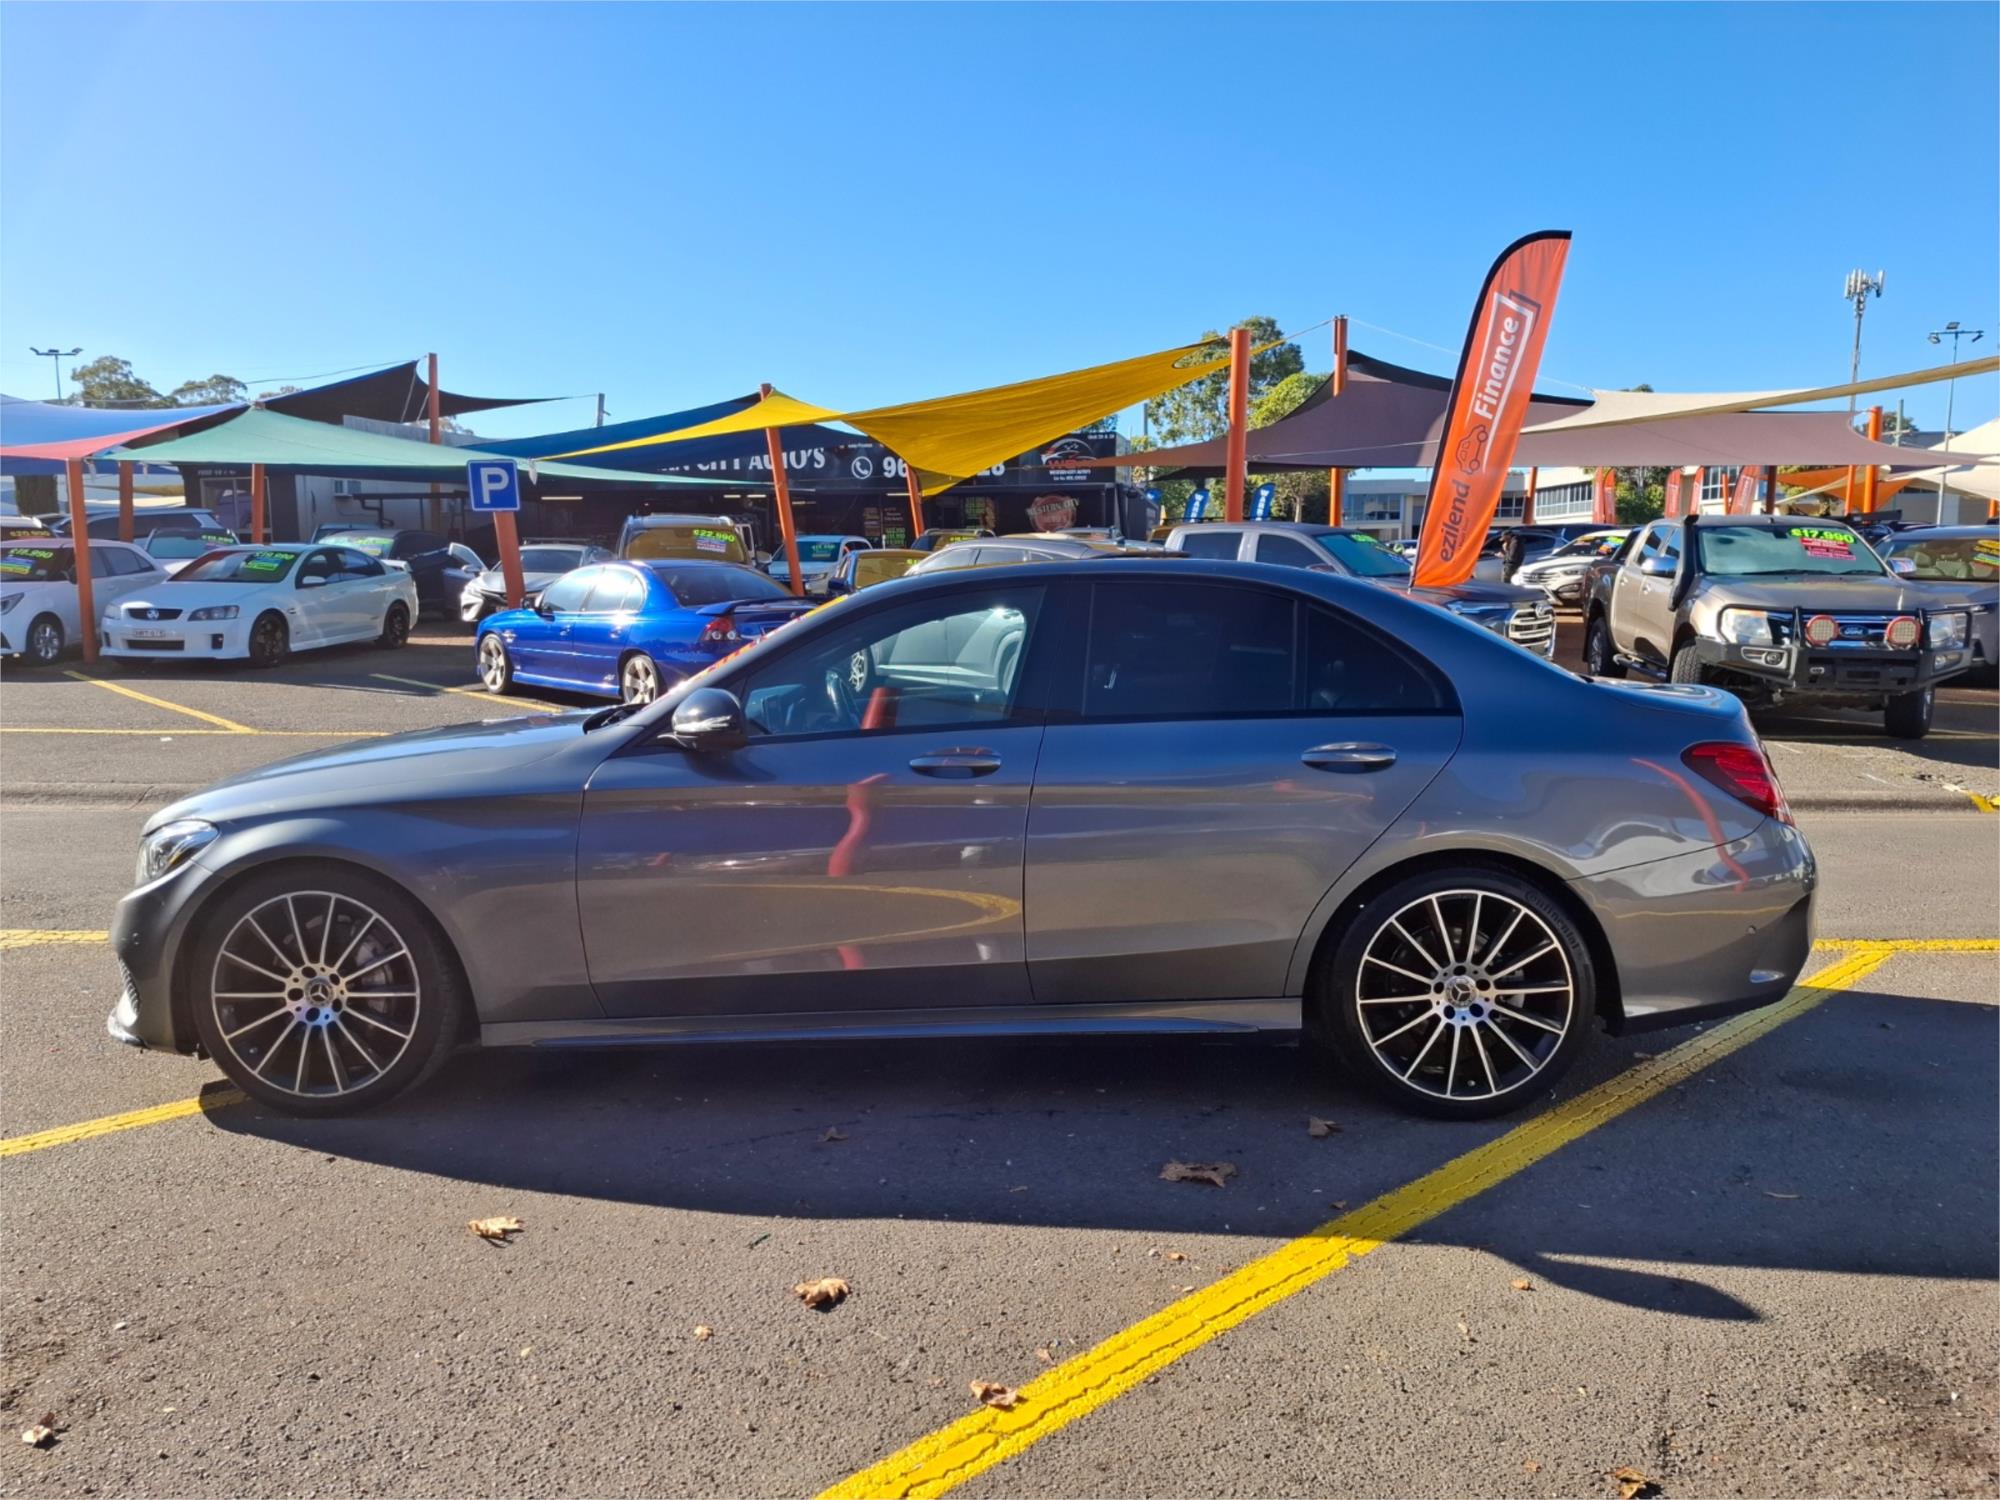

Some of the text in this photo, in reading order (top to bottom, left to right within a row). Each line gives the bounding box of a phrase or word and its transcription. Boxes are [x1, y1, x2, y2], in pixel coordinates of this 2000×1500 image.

[1474, 316, 1519, 420] Finance
[480, 467, 510, 504] P
[1440, 479, 1472, 562] ezilend
